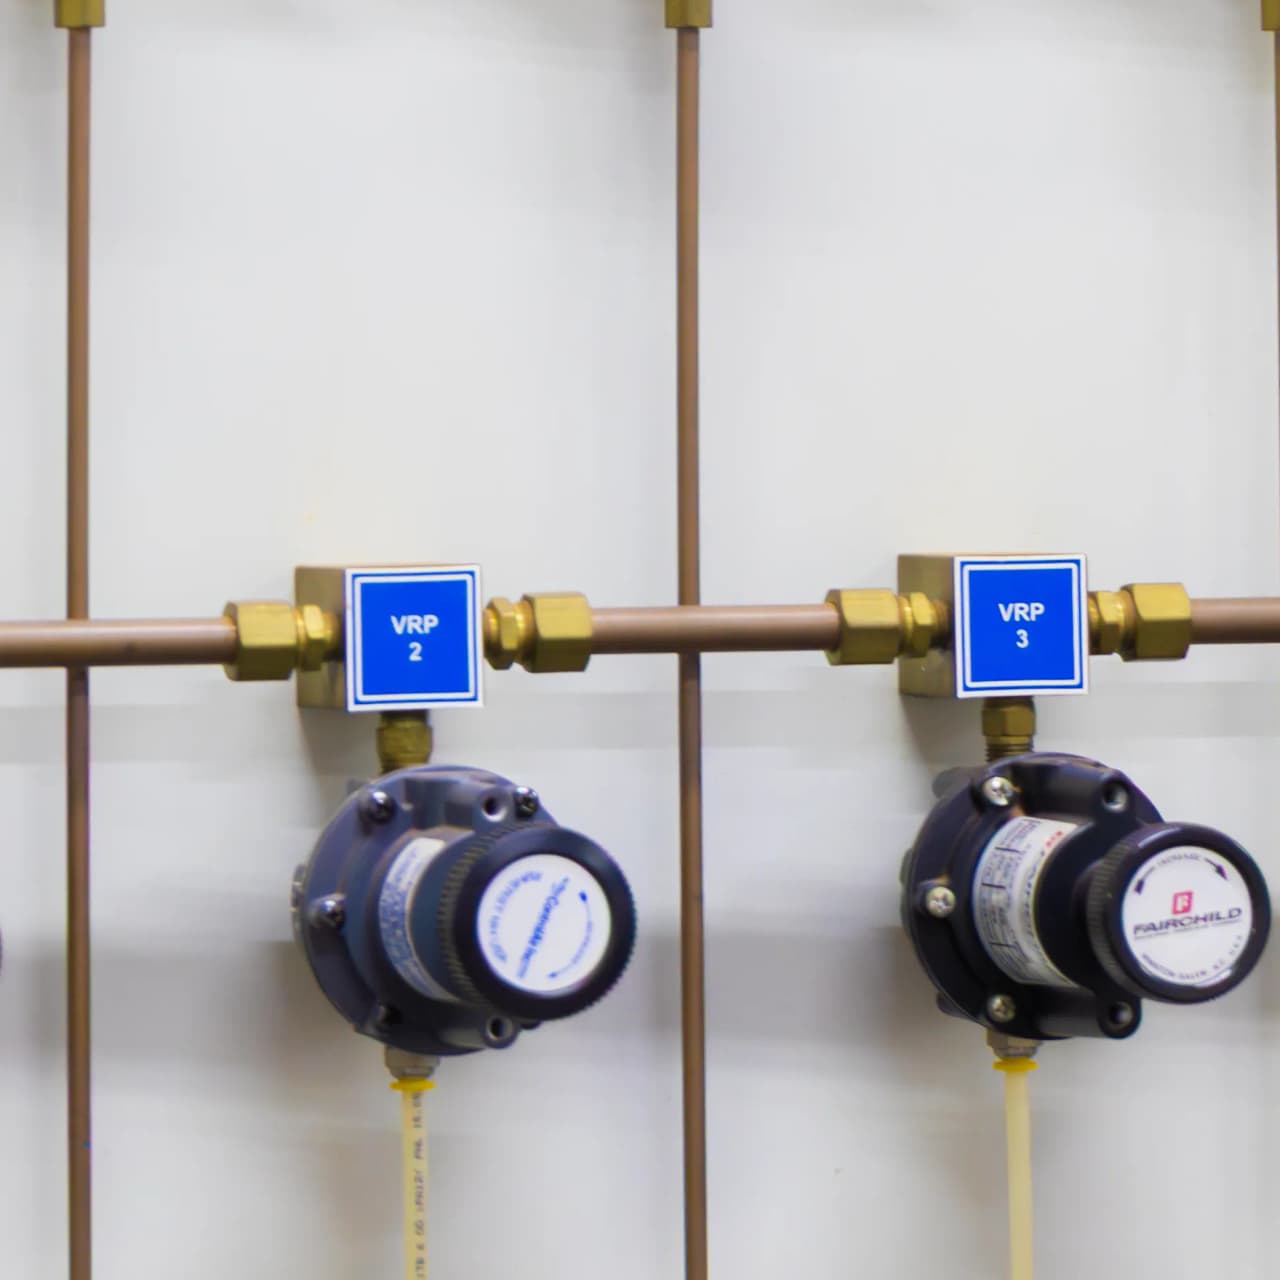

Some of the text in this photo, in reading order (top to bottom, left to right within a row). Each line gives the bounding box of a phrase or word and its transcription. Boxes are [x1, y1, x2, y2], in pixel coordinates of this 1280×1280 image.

[998, 602, 1046, 622] VRP
[390, 614, 439, 635] VRP
[1015, 628, 1030, 649] 3
[408, 641, 423, 662] 2
[1132, 906, 1244, 936] FAIRCHILD
